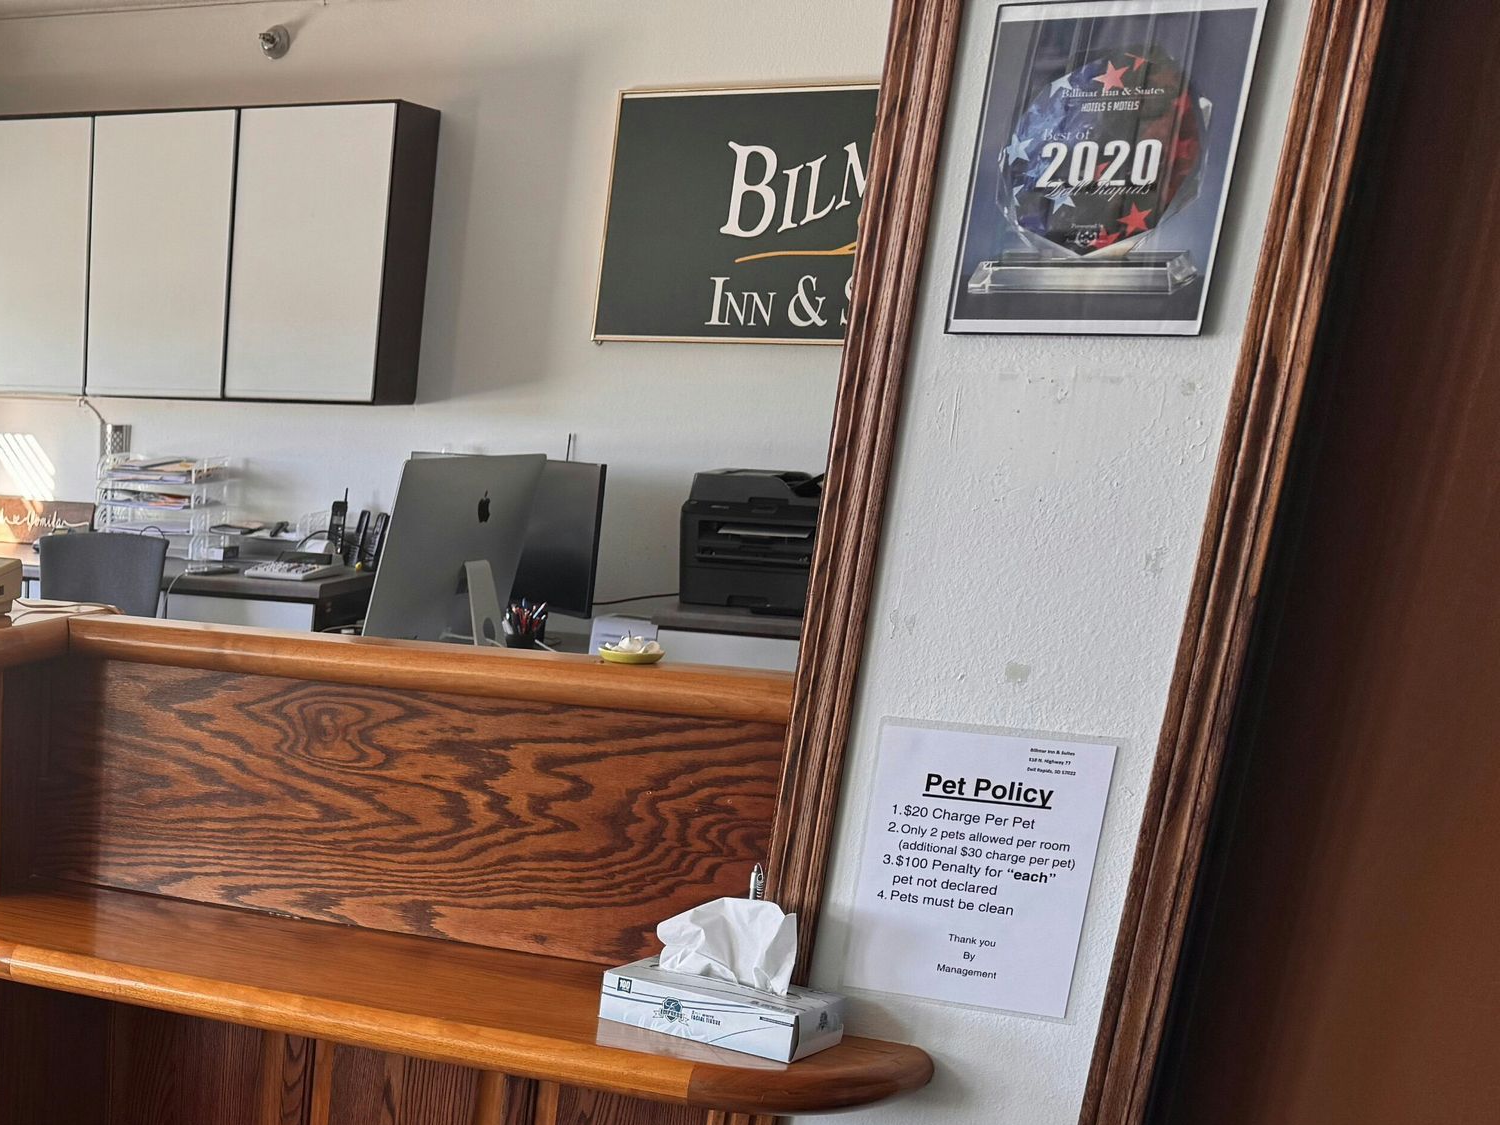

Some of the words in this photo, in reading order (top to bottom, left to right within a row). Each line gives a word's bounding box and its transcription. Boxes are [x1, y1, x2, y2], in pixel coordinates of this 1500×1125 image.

[1121, 87, 1132, 96] &
[1043, 128, 1071, 141] Best
[1075, 126, 1093, 140] of
[1035, 139, 1162, 188] 2020
[704, 277, 776, 326] INN
[787, 275, 828, 327] &
[925, 773, 966, 796] Pet
[973, 778, 1054, 807] Policy
[932, 808, 980, 825] Charge
[985, 813, 1008, 827] Per
[1012, 816, 1035, 830] Pet
[901, 824, 927, 838] Only
[930, 828, 938, 838] 2
[941, 830, 965, 842] pets
[969, 833, 1014, 846] allowed
[1016, 839, 1037, 850] per
[1040, 842, 1071, 852] room
[899, 839, 957, 856] (additional
[960, 847, 982, 858] $30
[986, 850, 1026, 865] charge
[1029, 856, 1049, 867] per
[1052, 858, 1076, 871] pet)
[932, 859, 980, 878] Penalty
[985, 866, 1003, 878] for
[892, 874, 912, 886] pet
[917, 877, 937, 889] not
[941, 879, 998, 896] declared
[890, 890, 918, 903] Pets
[922, 896, 954, 909] must
[958, 899, 974, 911] be
[978, 902, 1014, 916] clean
[948, 933, 977, 944] Thank
[979, 939, 996, 948] you
[963, 951, 976, 962] By
[937, 963, 996, 979] Management
[619, 978, 631, 991] 100
